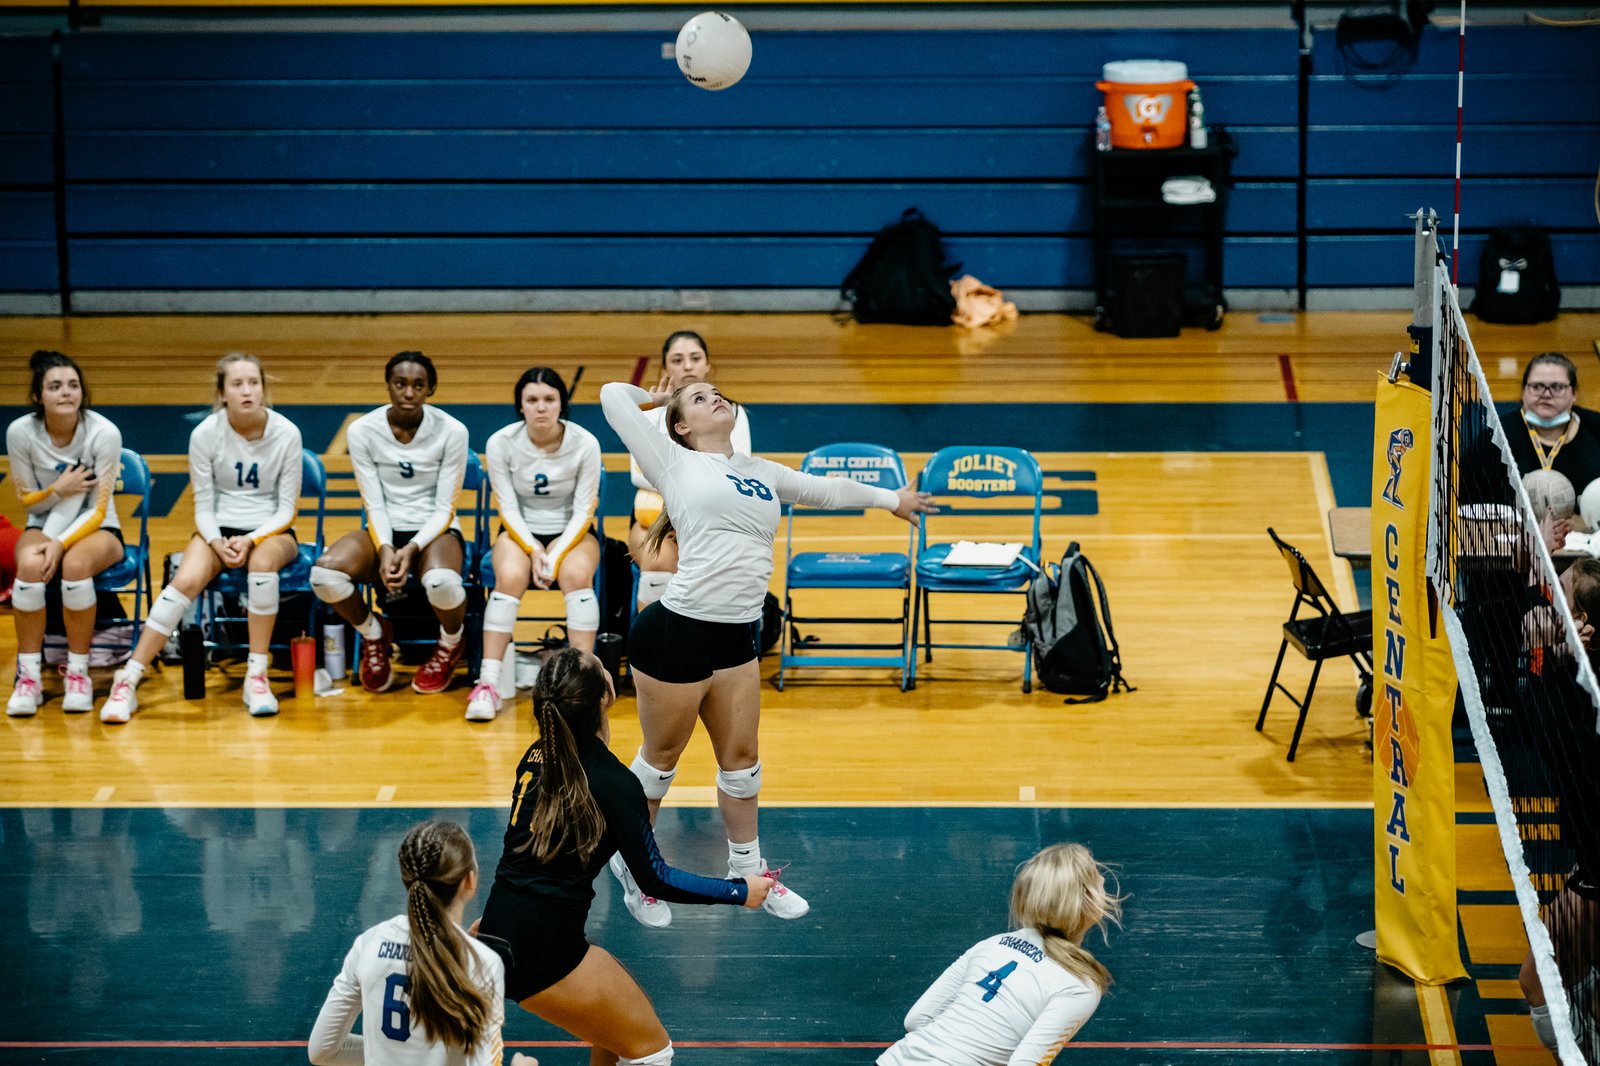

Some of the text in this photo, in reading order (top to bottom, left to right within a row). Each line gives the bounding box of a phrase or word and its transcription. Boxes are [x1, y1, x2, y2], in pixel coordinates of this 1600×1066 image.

[235, 461, 259, 489] 14
[399, 460, 415, 479] 9
[947, 454, 1017, 478] JOLIET
[533, 473, 550, 496] 2
[947, 478, 1016, 492] BOOSTERS
[1383, 522, 1410, 896] CENTRAL
[975, 960, 1019, 1003] 4
[381, 972, 413, 1043] 6
